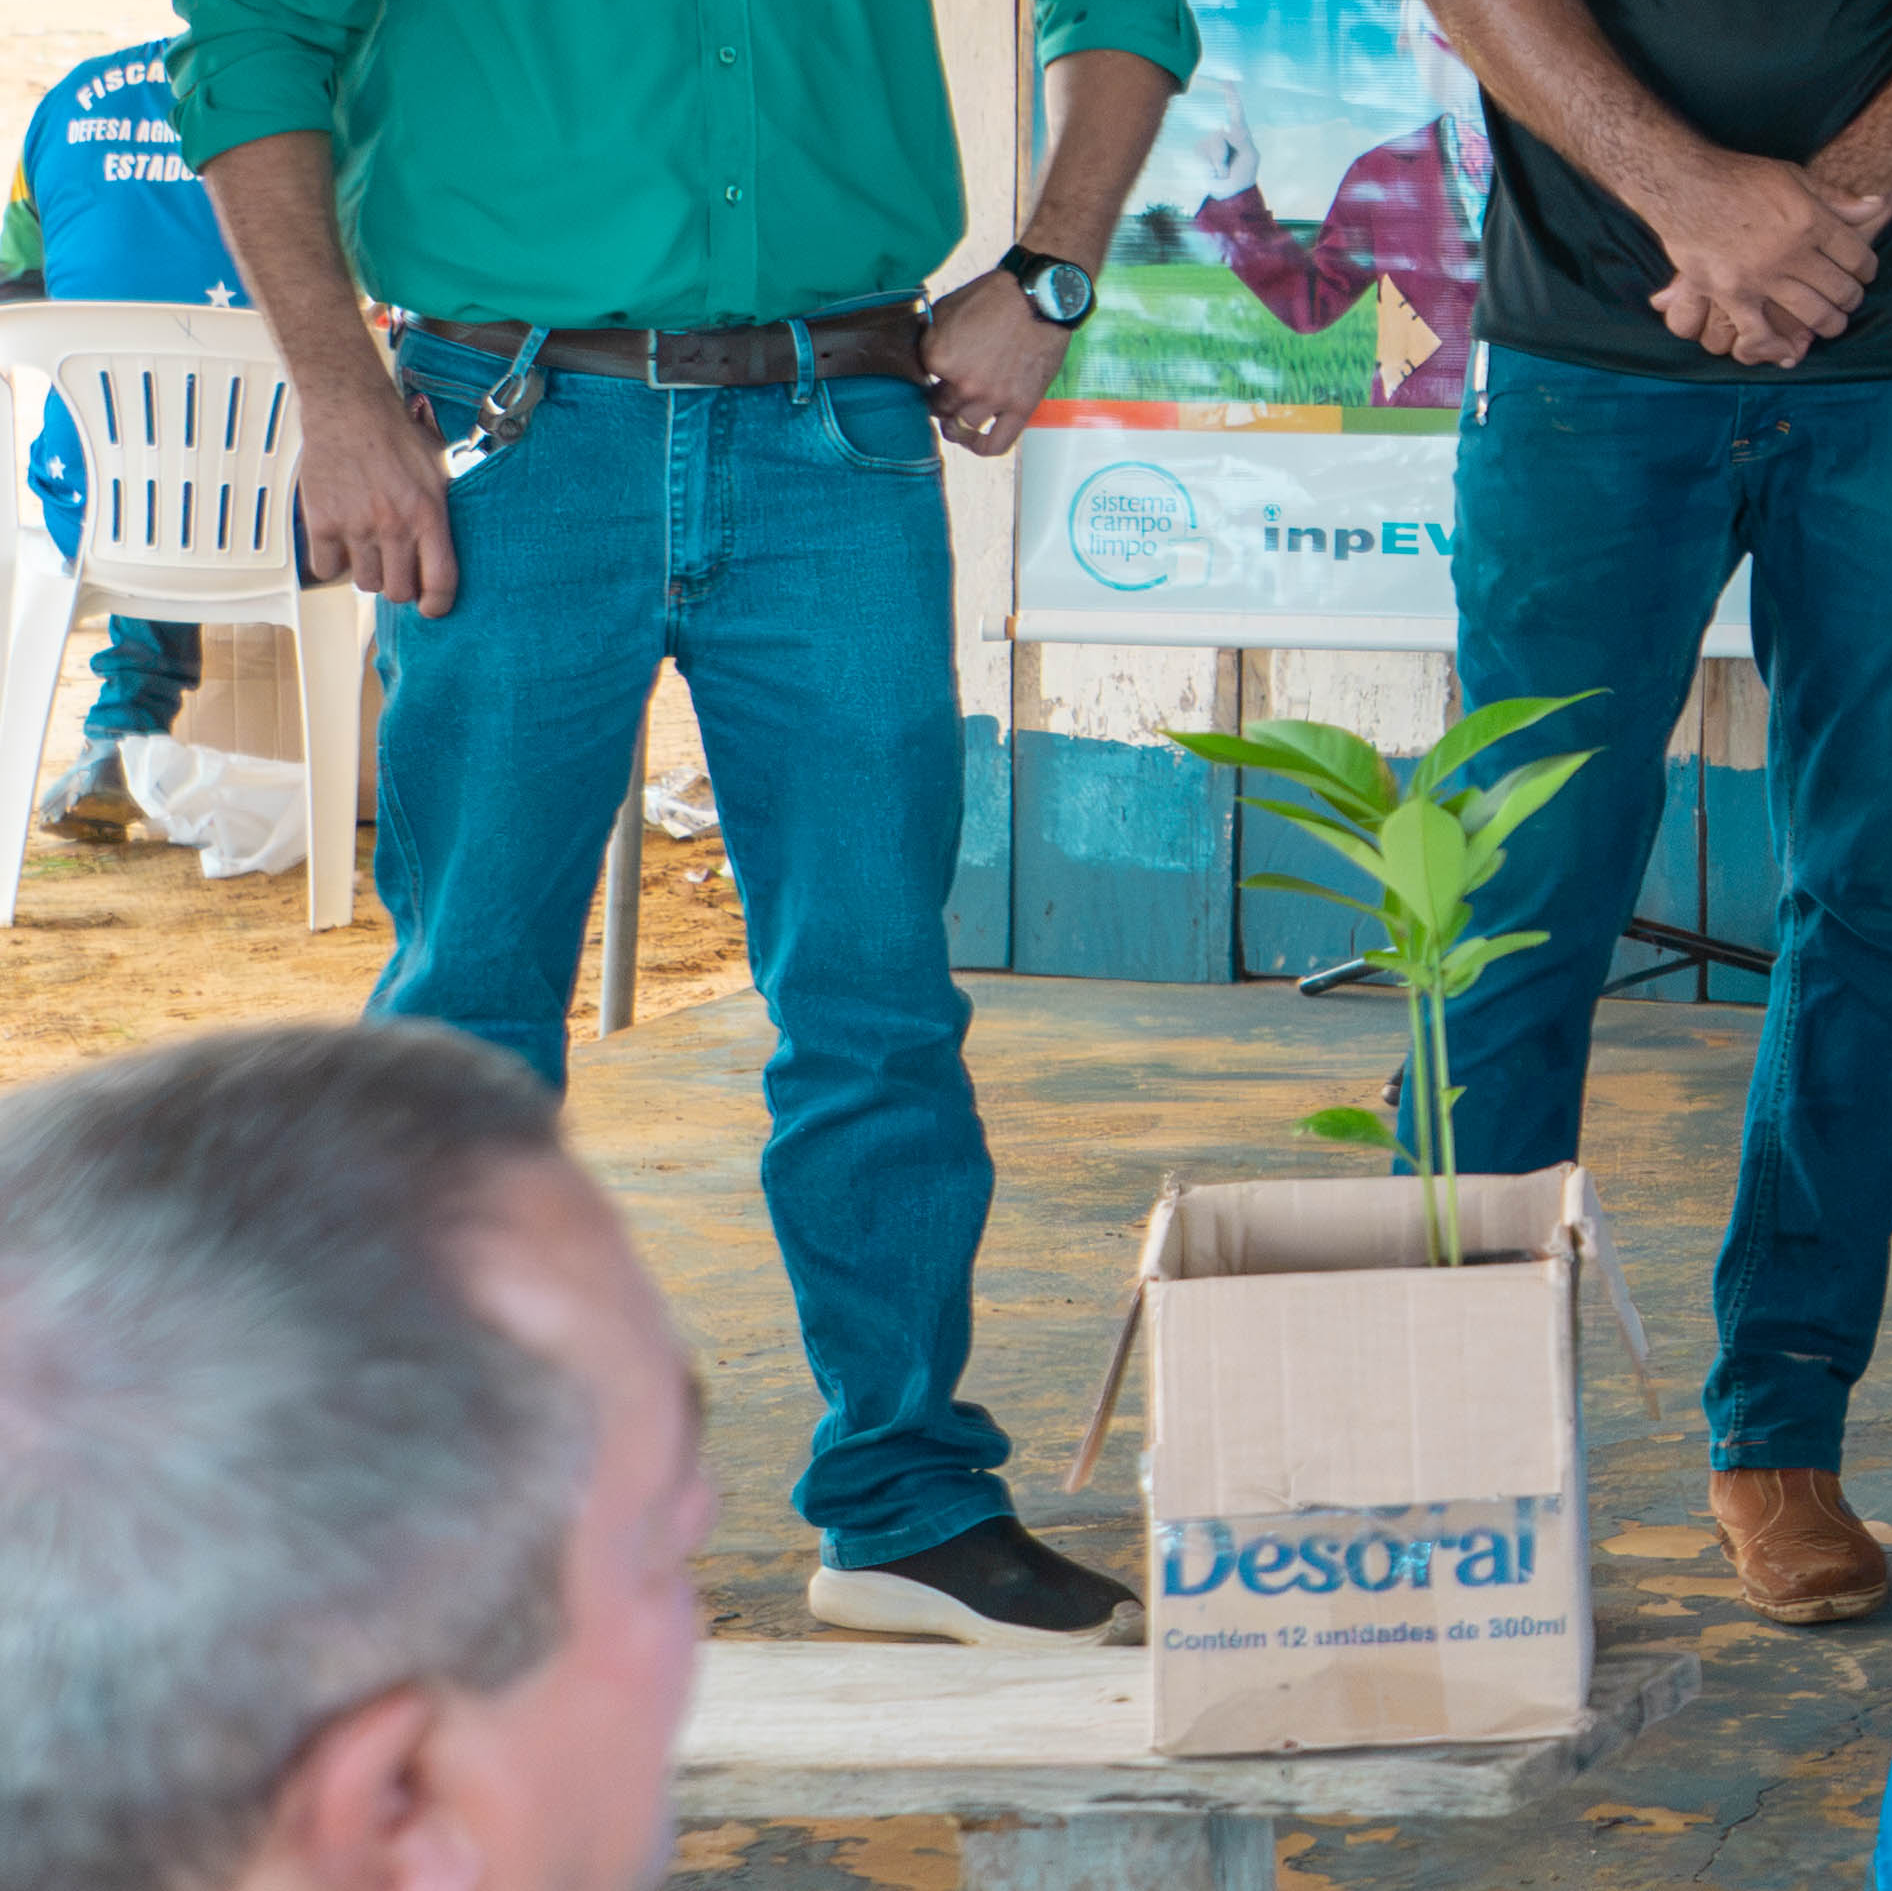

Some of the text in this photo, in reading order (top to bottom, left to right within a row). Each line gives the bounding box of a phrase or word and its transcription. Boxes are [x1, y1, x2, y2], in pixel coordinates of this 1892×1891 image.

[76, 58, 172, 111] FISCA
[67, 118, 131, 145] DEFESA
[1091, 490, 1177, 514] sistema
[1090, 512, 1172, 534] campo
[1264, 504, 1458, 560] inpEV
[1089, 534, 1157, 562] limpo
[1163, 1628, 1267, 1651] Contém
[1277, 1629, 1308, 1648] 12
[1314, 1618, 1436, 1646] unidades
[1448, 1618, 1479, 1641] de
